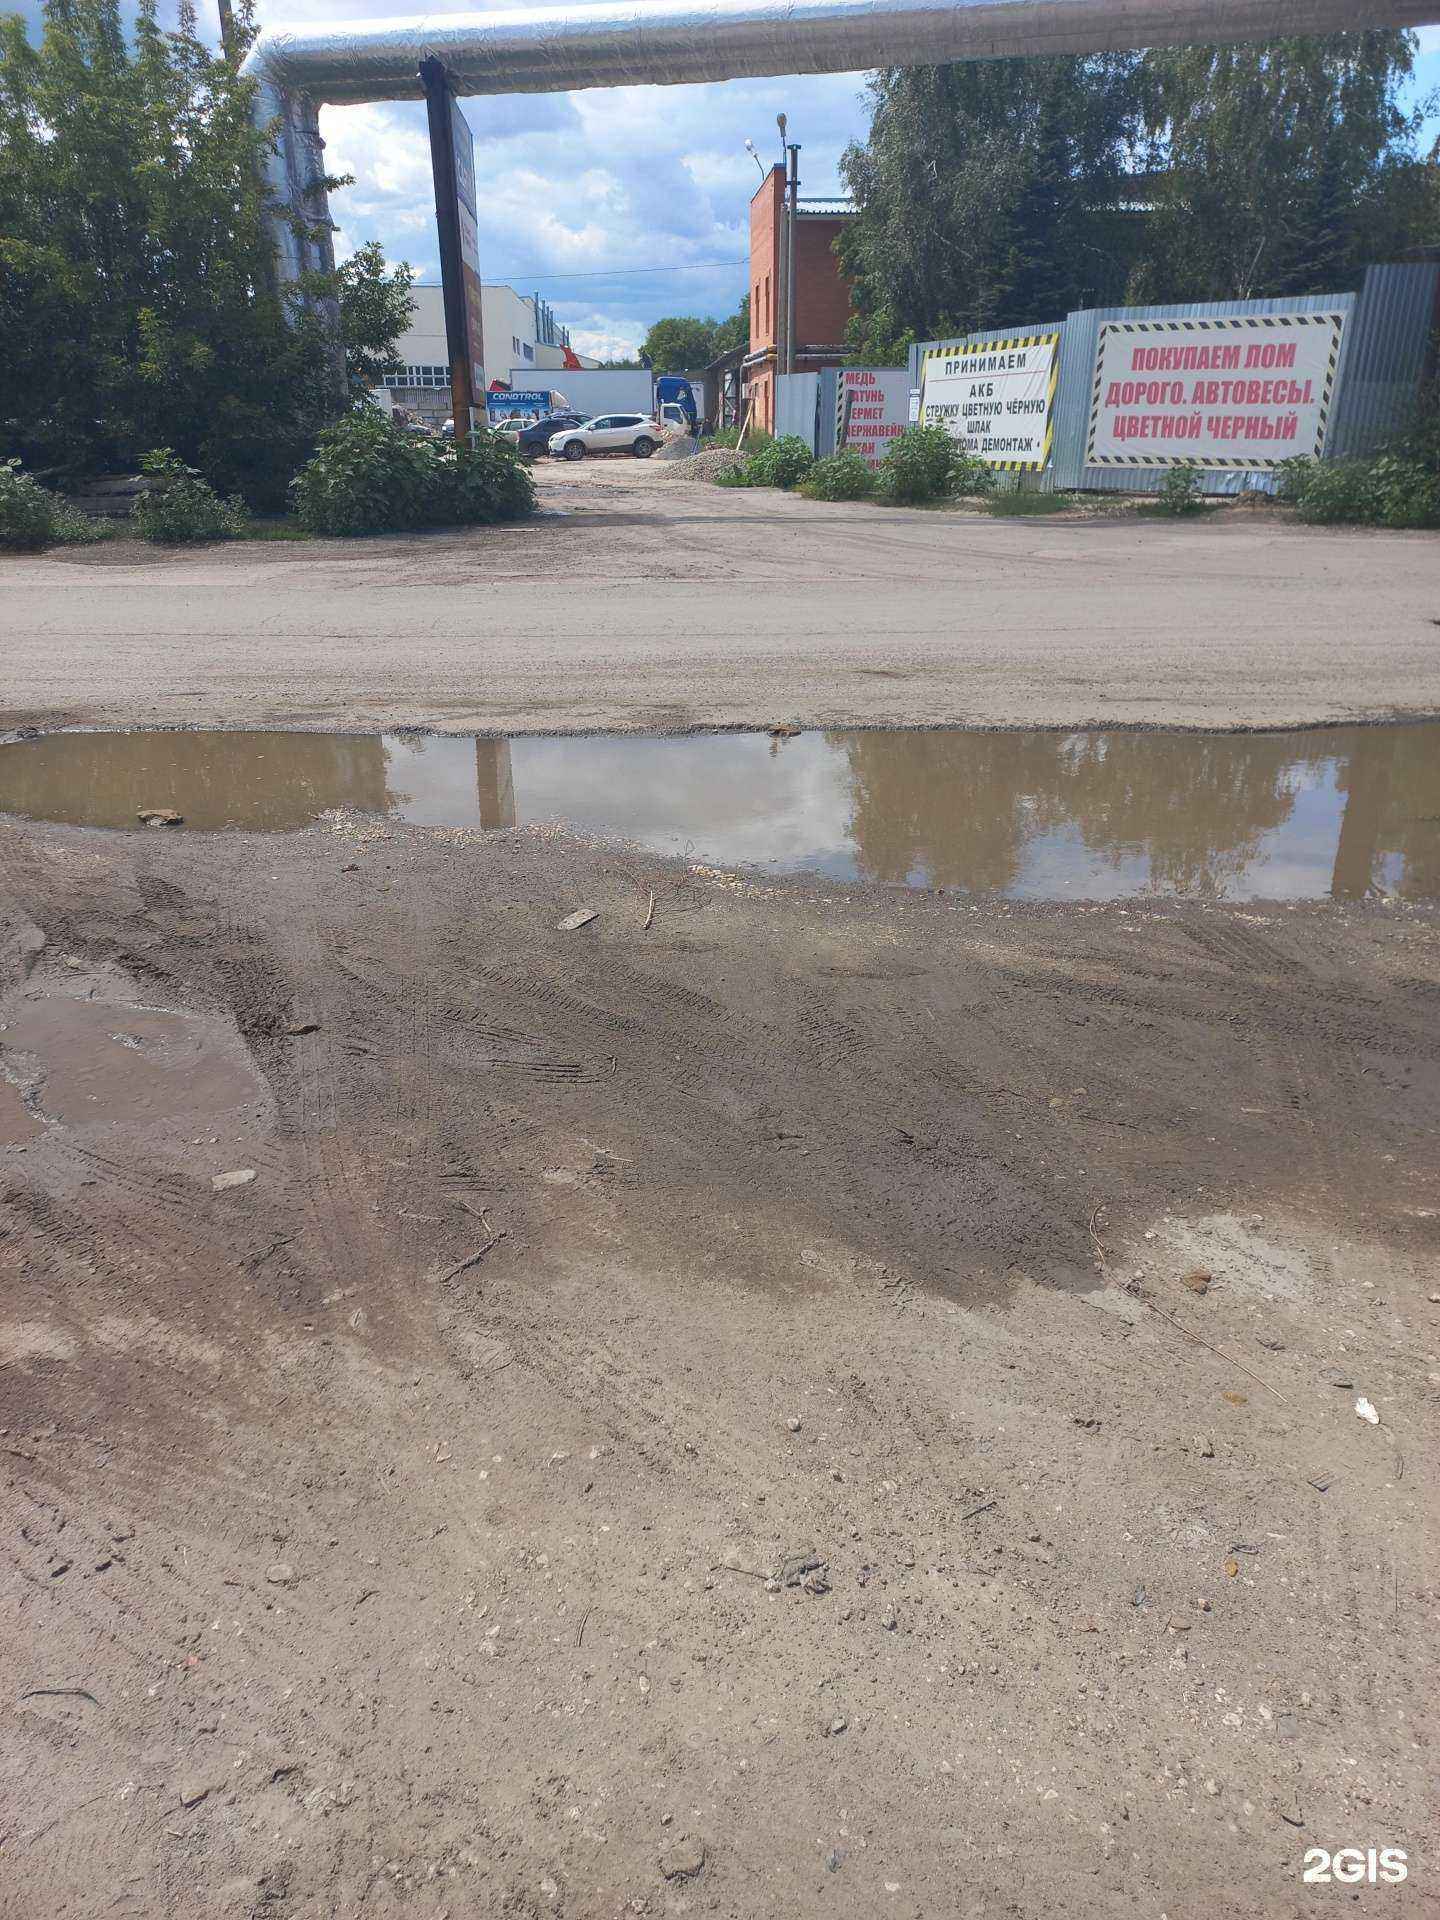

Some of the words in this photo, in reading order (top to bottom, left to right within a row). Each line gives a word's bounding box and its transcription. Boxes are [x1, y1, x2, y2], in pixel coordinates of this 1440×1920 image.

[945, 353, 1027, 375] ПРИНИМАЕМ
[1131, 344, 1241, 371] ПОКУПАЕМ
[1244, 343, 1297, 369] ЛОМ
[845, 373, 876, 386] МЕДЬ
[492, 392, 544, 401] CONDTROL
[849, 390, 885, 403] АТУНЬ
[969, 383, 994, 398] АКБ
[1105, 381, 1187, 408] ДОРОГО.
[1191, 379, 1315, 405] АВТОВЕСЫ.
[851, 407, 885, 421] ЕРМЕТ
[962, 402, 1003, 419] ЦВЕТНУЮ
[967, 420, 992, 434] ШЛАК
[1112, 410, 1201, 442] ЦВЕТНОЙ
[1206, 410, 1299, 440] ЧЕРНЫЙ
[981, 437, 1034, 453] ДЕМОНТАЖ
